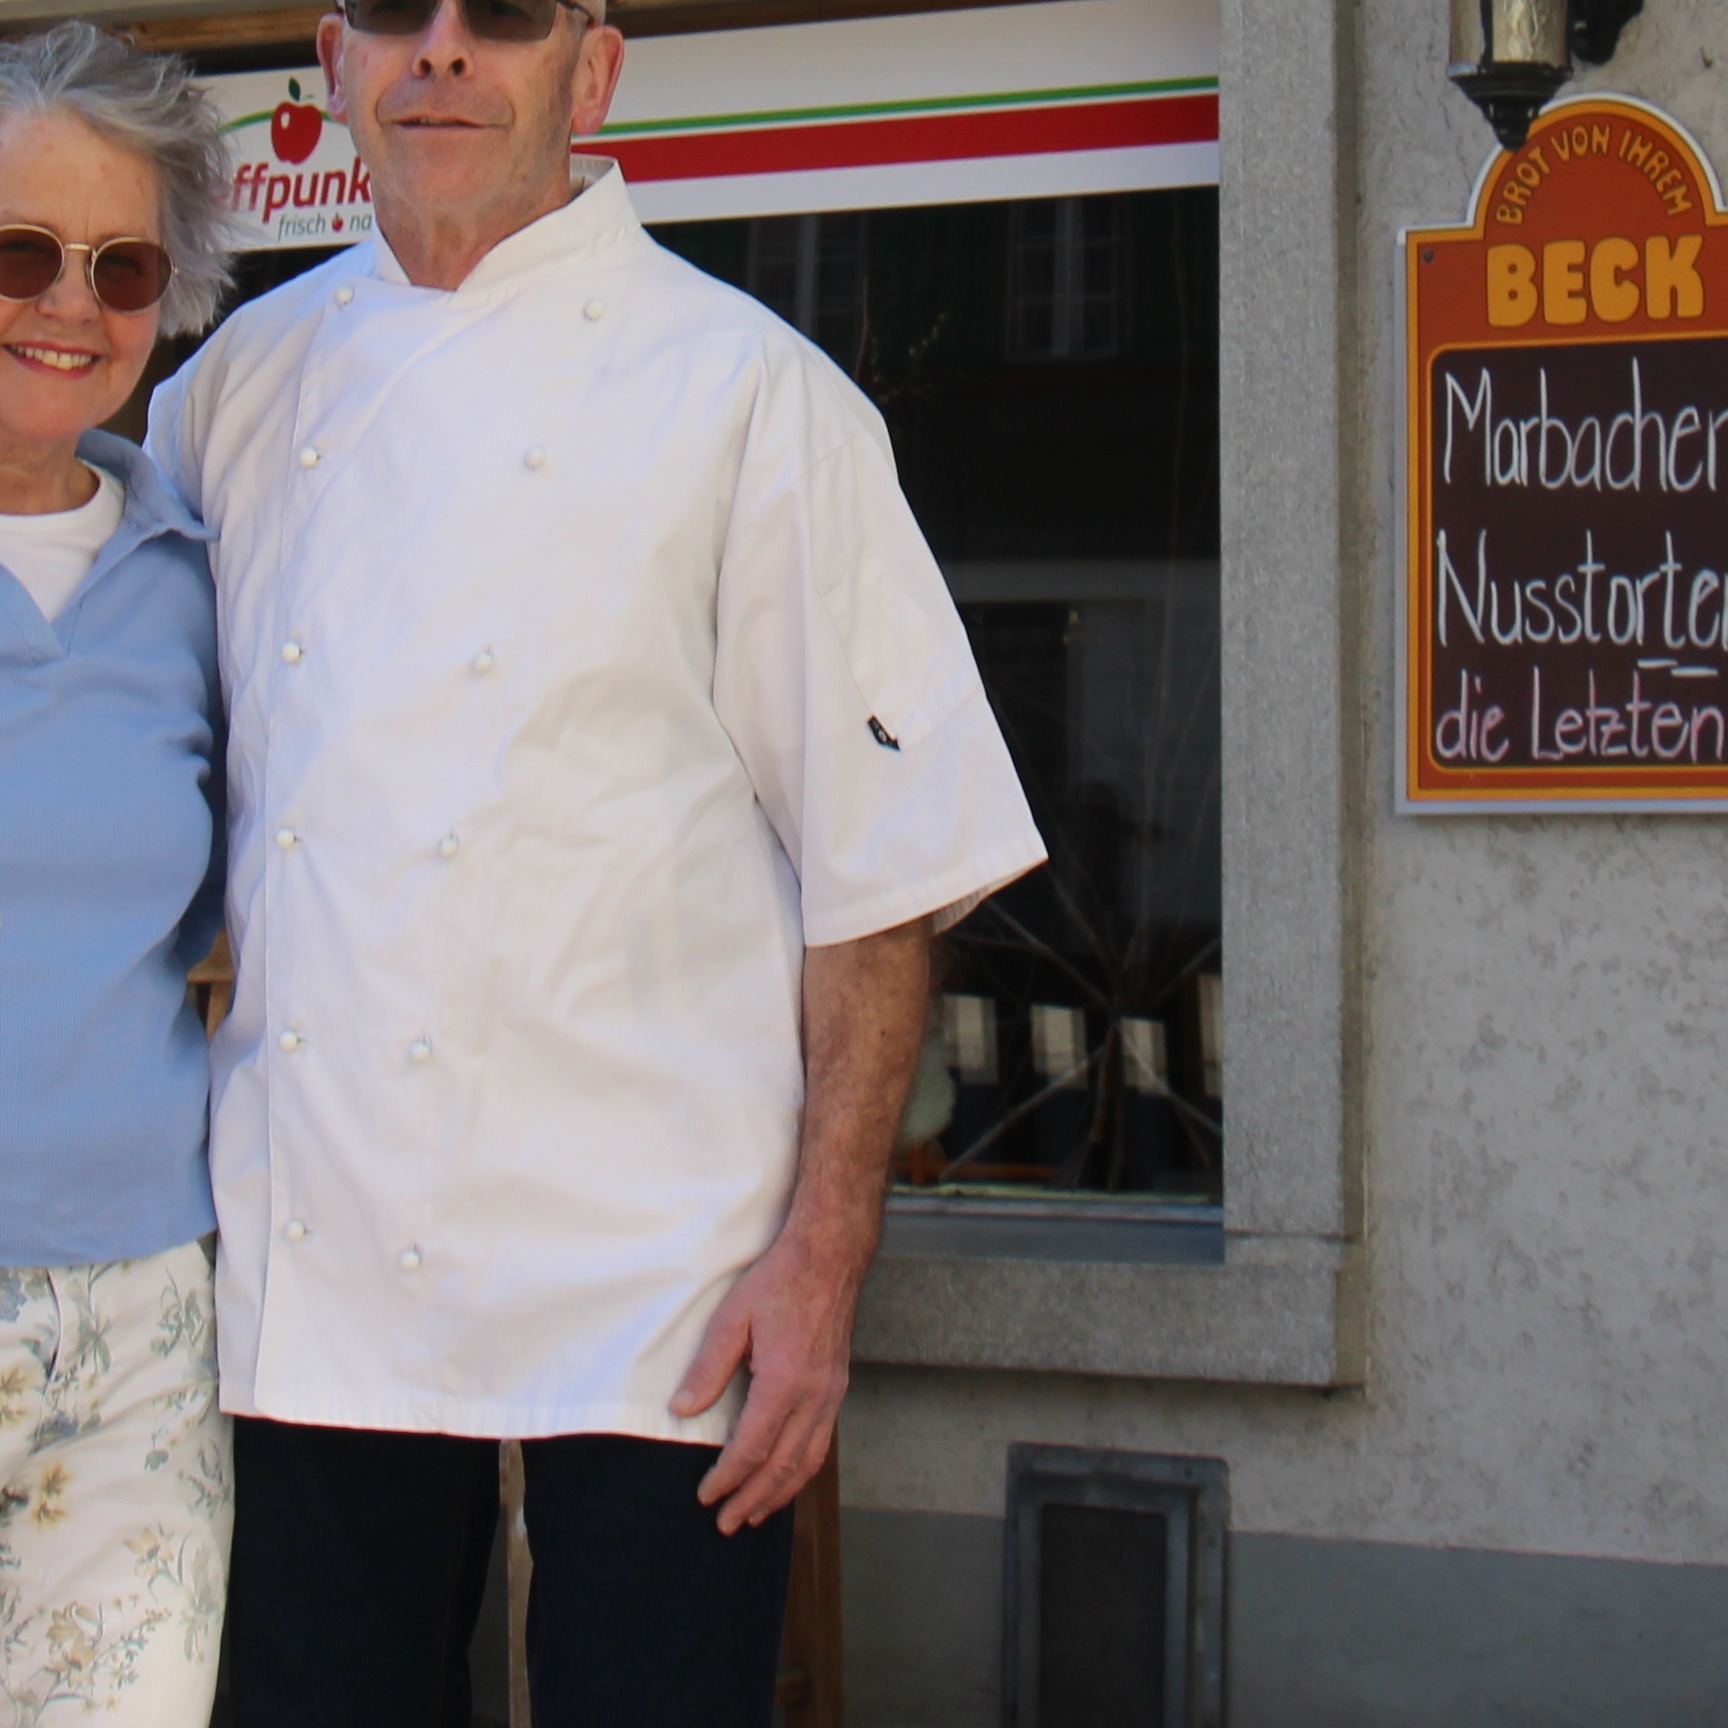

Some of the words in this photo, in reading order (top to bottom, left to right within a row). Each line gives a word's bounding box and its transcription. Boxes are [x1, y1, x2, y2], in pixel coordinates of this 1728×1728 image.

[1496, 146, 1550, 224] BROT
[1550, 124, 1610, 161] VON
[1619, 129, 1692, 215] IHREM
[278, 212, 326, 241] frisch
[349, 213, 372, 231] na
[1487, 235, 1704, 328] BECK
[1436, 669, 1509, 762] die
[1531, 666, 1726, 764] Letzten
